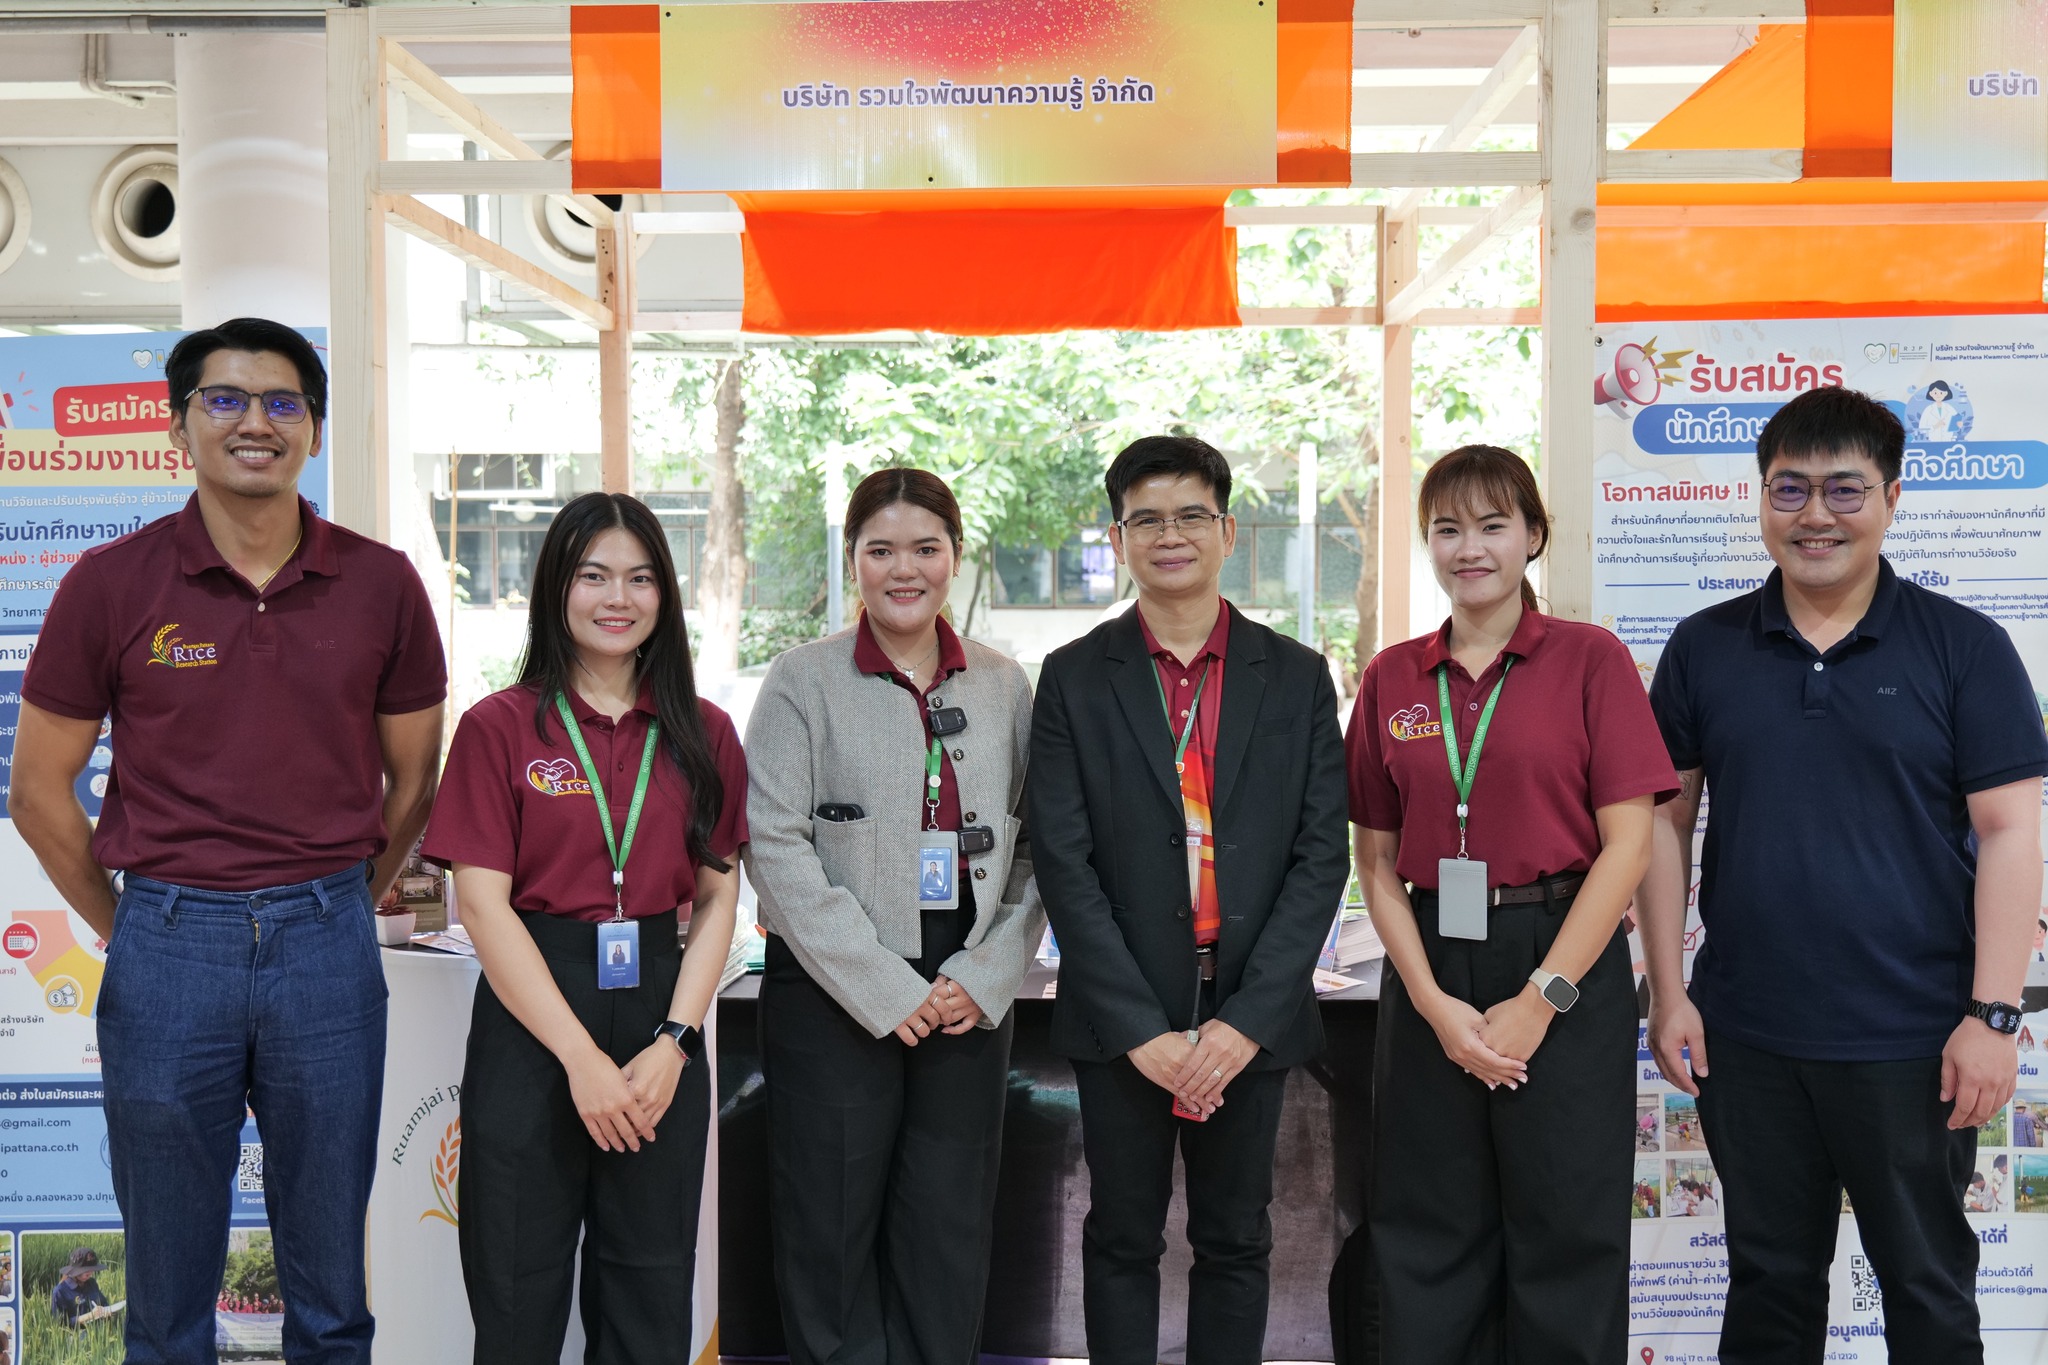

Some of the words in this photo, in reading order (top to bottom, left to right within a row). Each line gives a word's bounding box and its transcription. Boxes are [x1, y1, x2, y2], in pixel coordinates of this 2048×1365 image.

[783, 84, 849, 108] บริษัท
[858, 79, 1083, 111] รวมใจพัฒนาความรู้
[1092, 79, 1154, 104] จำกัด
[1969, 71, 2037, 96] บริษัท
[1690, 352, 1844, 393] รับสมัคร
[1899, 444, 2026, 481] กิจศึกษา
[1602, 481, 1730, 502] โอกาสพิเศษ
[173, 646, 217, 662] Rice
[1406, 724, 1440, 737] Rice
[551, 781, 591, 793] Rice
[0, 1118, 71, 1129] @gmail.com
[392, 1087, 444, 1166] Ruamjai
